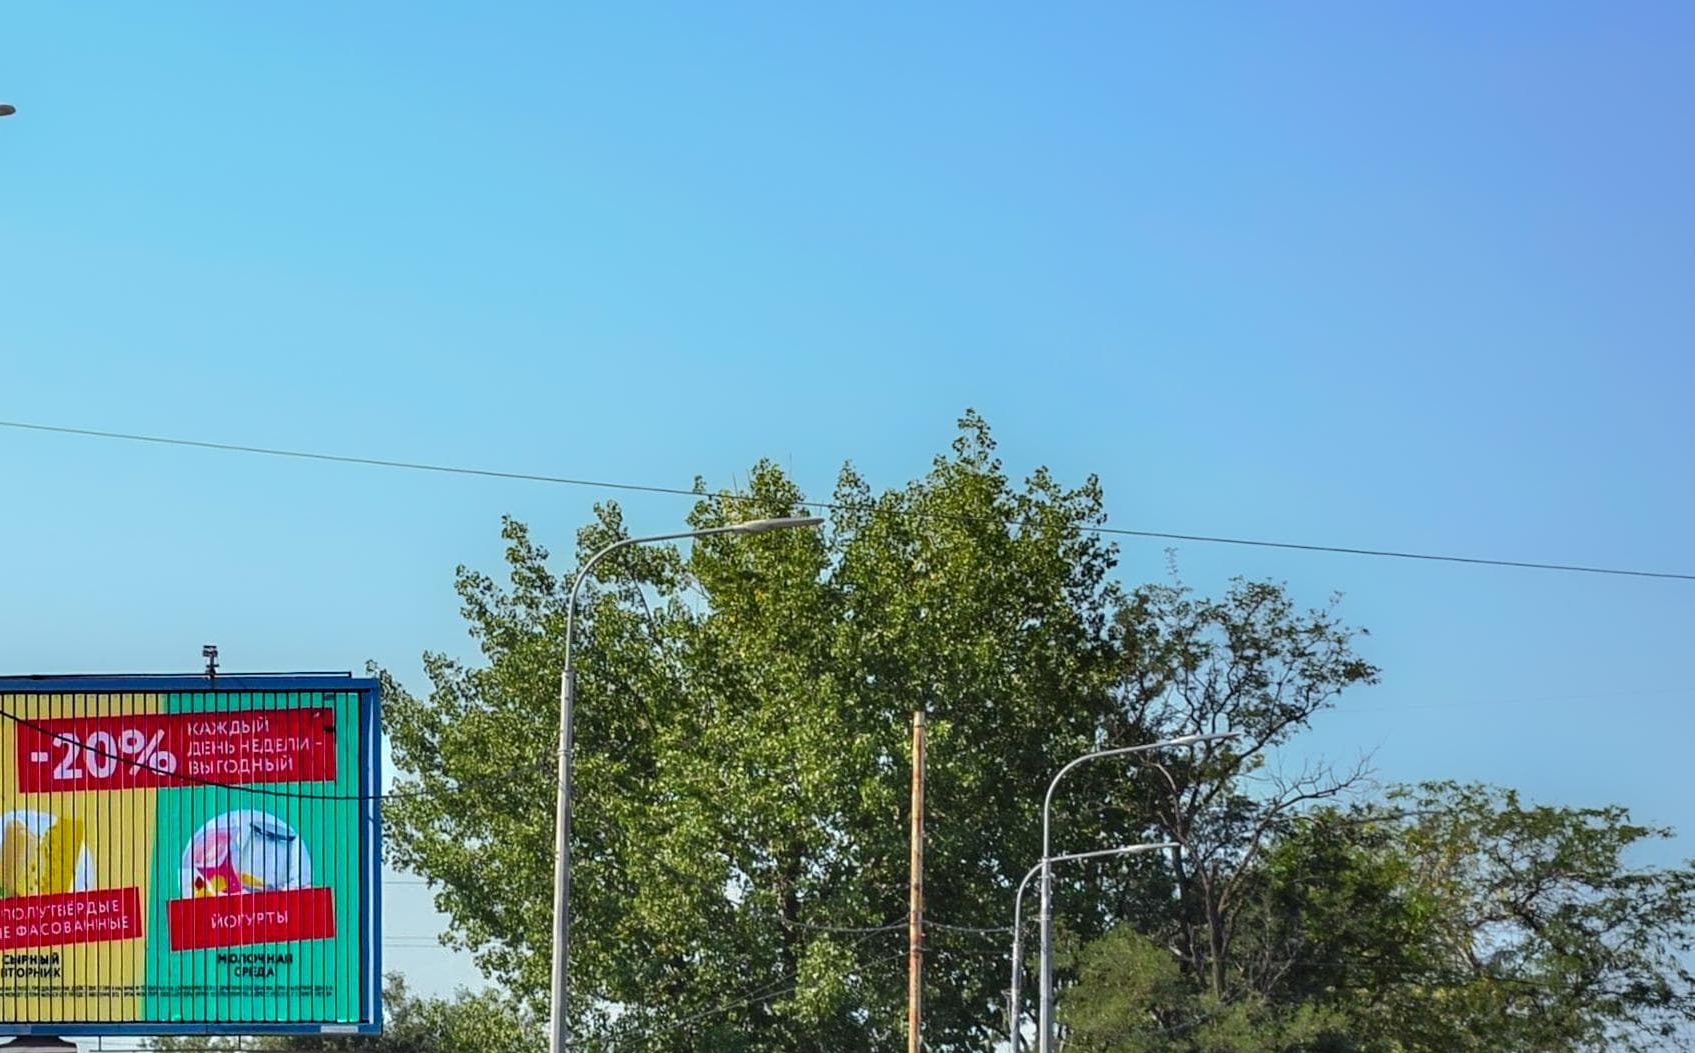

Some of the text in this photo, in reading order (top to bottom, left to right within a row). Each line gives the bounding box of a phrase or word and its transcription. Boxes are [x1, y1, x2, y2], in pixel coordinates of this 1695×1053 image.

[188, 716, 269, 736] КАЖДЫЙ
[30, 729, 178, 778] -20%
[187, 740, 235, 757] ДЕНЬ
[240, 737, 310, 754] НЕДЕЛИ
[188, 755, 294, 775] ВЫГОДНЫЙ
[15, 916, 130, 937] ФАСОВАННЫЕ
[211, 910, 289, 929] ЙОГУРТЫ
[2, 952, 60, 965] СЫРНЫЙ
[216, 953, 294, 965] МОЛОЧНАЯ
[1, 967, 62, 978] ВТОРНИК
[234, 966, 276, 978] СРЕДА
